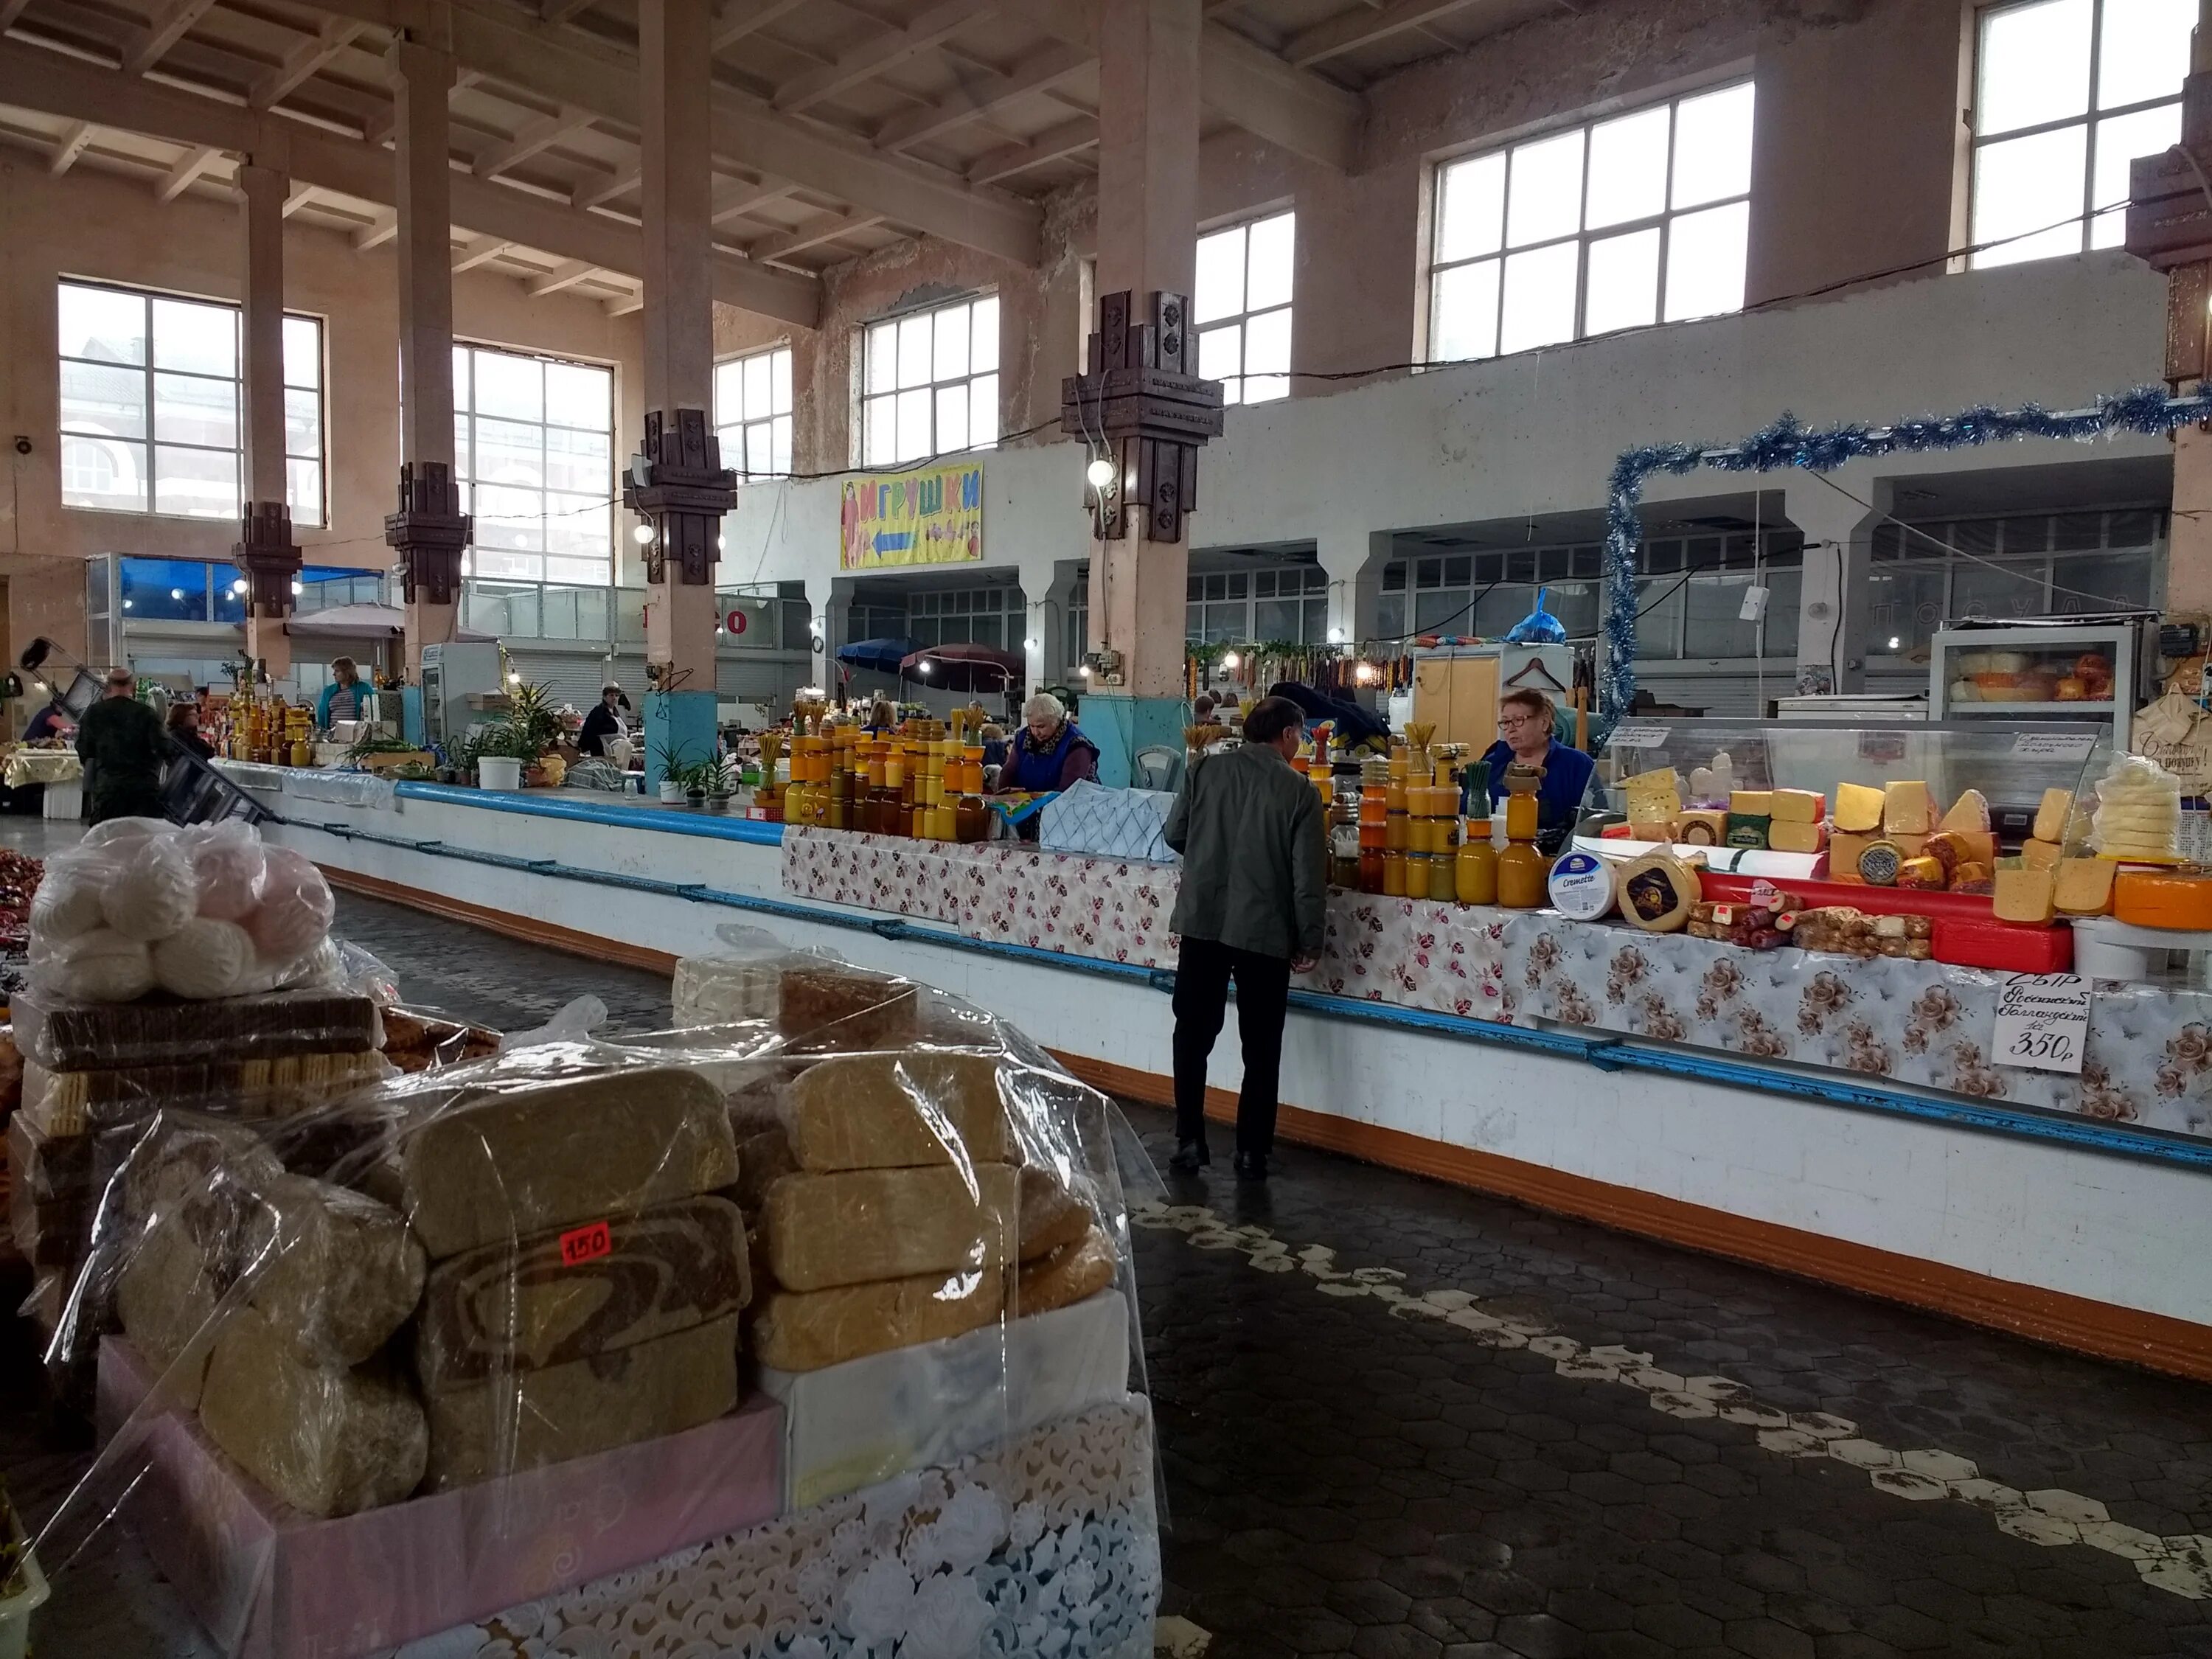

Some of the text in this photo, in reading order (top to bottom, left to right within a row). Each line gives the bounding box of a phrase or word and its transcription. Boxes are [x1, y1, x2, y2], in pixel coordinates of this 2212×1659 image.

[860, 469, 981, 524] ИГРУШКИ
[1562, 874, 1595, 888] Cremette
[566, 1230, 605, 1260] 150
